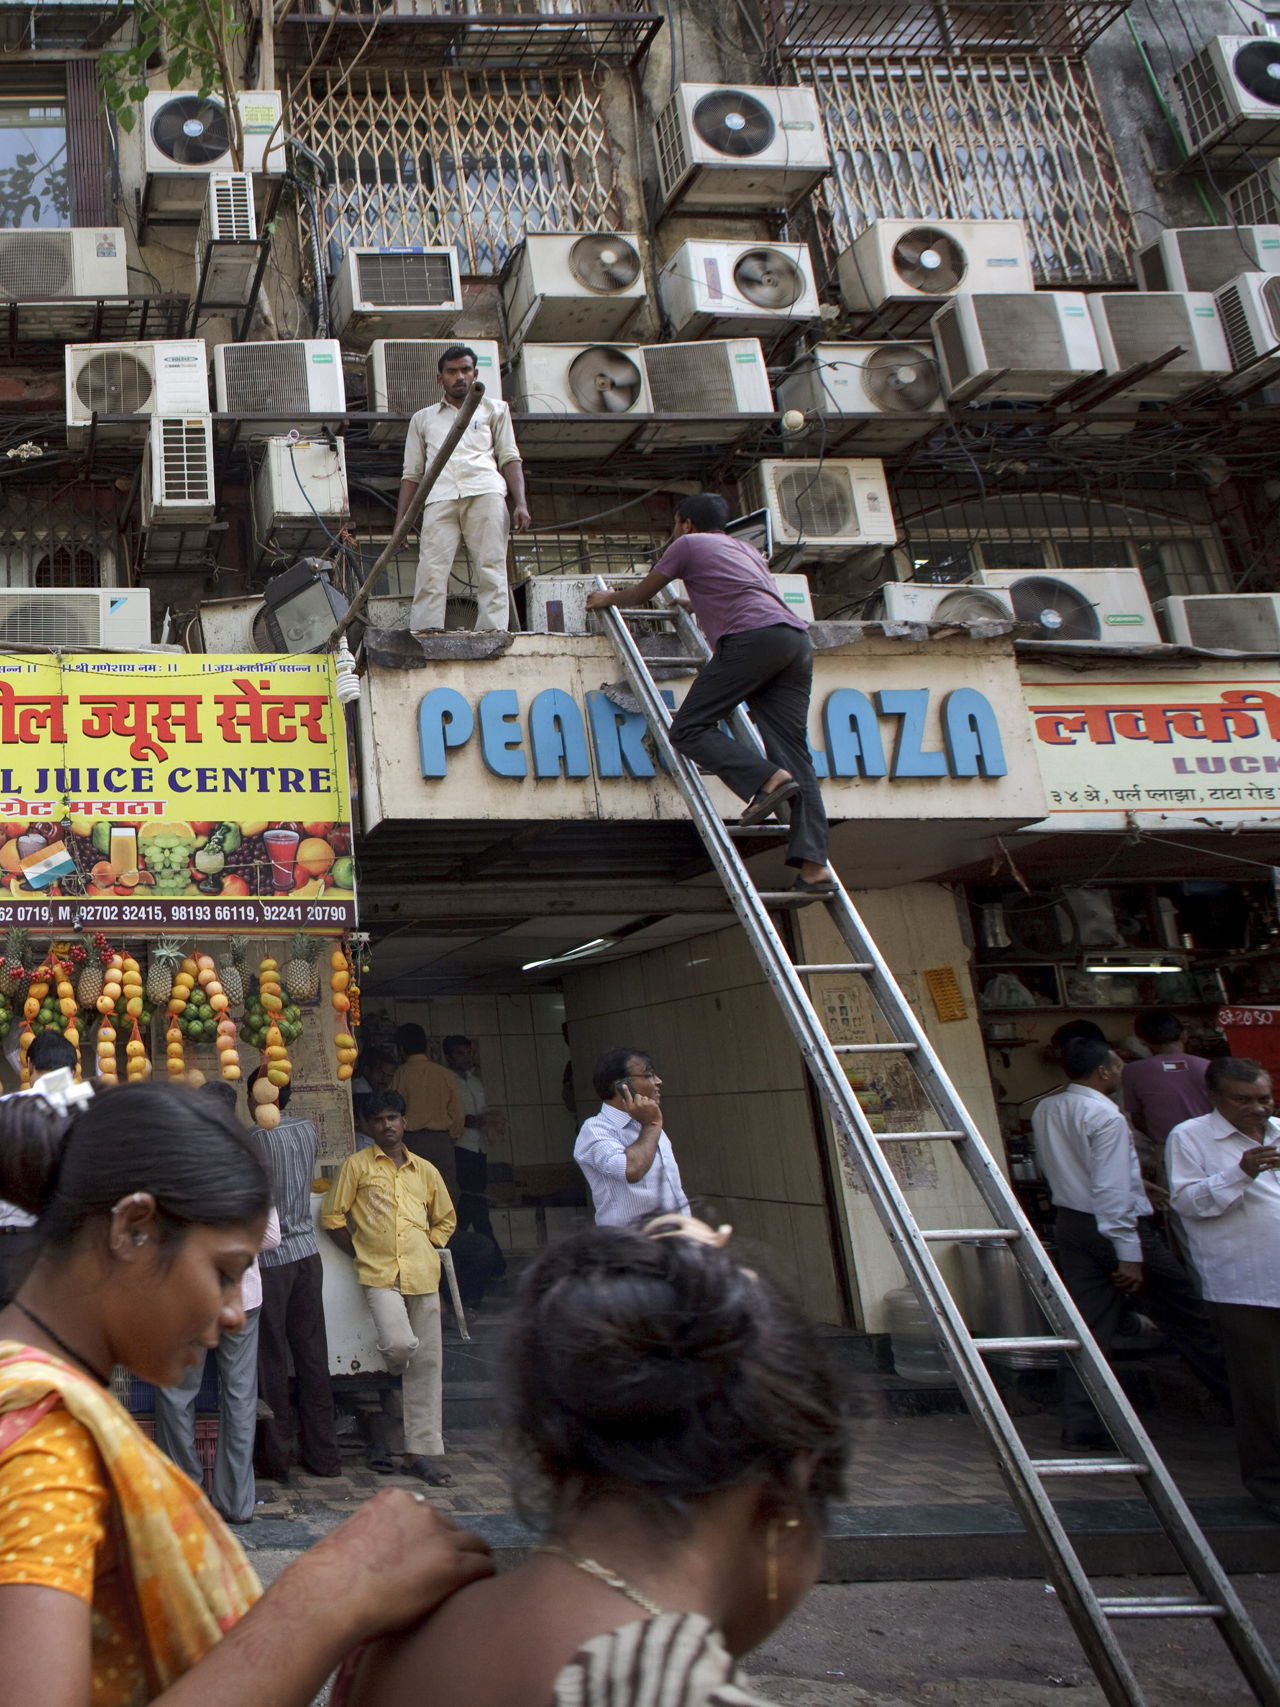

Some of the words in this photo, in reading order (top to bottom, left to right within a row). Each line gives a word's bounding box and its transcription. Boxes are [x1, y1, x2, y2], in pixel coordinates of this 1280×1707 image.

[75, 662, 89, 673] श्री
[214, 664, 233, 673] जय
[79, 694, 203, 764] ज्यूस
[214, 678, 329, 744] सेंटर
[417, 687, 676, 779] PEAR
[34, 767, 154, 794] JUICE
[168, 767, 331, 793] CENTRE
[1208, 788, 1242, 801] टाटा
[1245, 782, 1275, 801] रोड
[69, 800, 168, 817] मराठा
[79, 906, 119, 921] 92702
[122, 906, 167, 922] 32415,
[171, 906, 211, 921] 98193
[215, 906, 260, 922] 66119,
[263, 906, 303, 921] 92241
[307, 906, 347, 921] 20790
